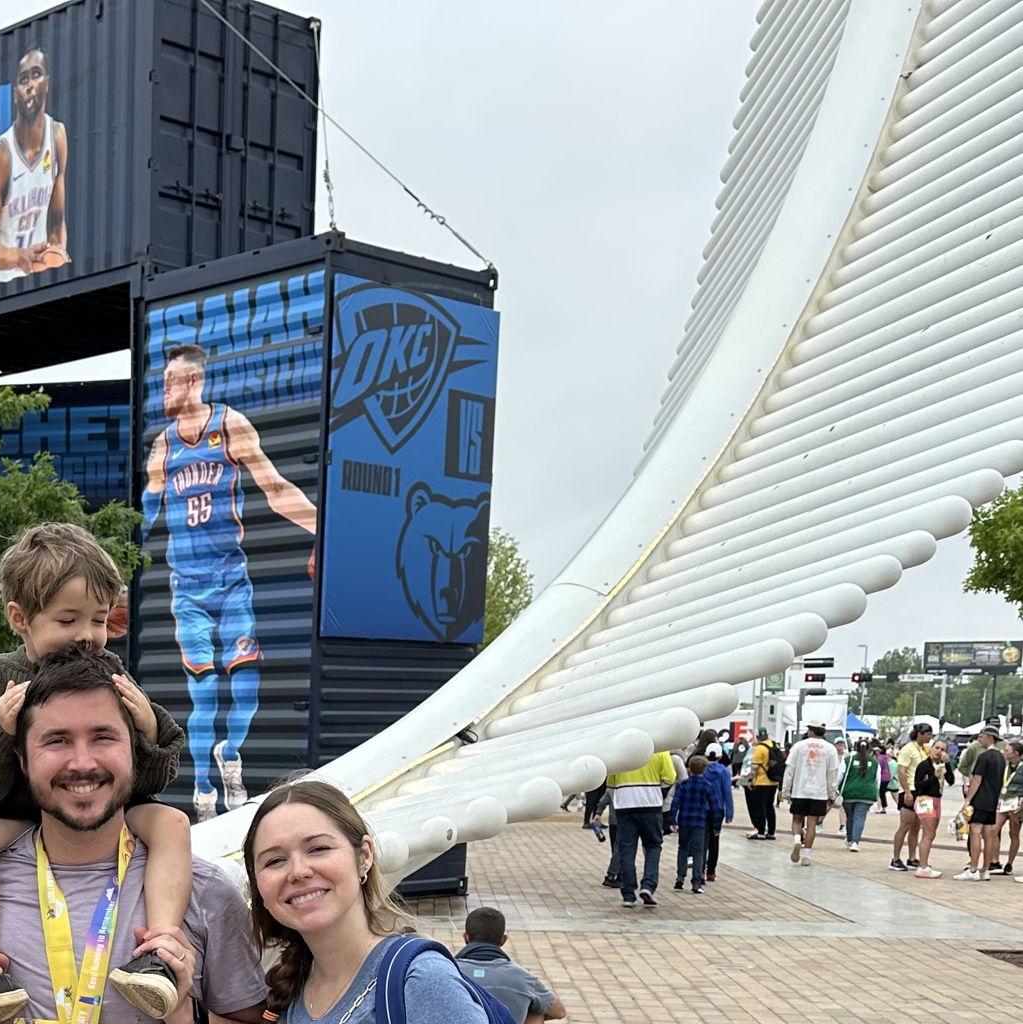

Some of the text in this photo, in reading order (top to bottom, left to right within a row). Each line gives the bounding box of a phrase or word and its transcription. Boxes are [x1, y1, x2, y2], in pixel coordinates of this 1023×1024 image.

[148, 270, 325, 370] ISAIAH
[333, 323, 433, 408] OKC
[458, 398, 485, 475] VS
[172, 461, 224, 495] THUNDER
[341, 459, 401, 498] ROUND 1
[187, 492, 212, 527] 55
